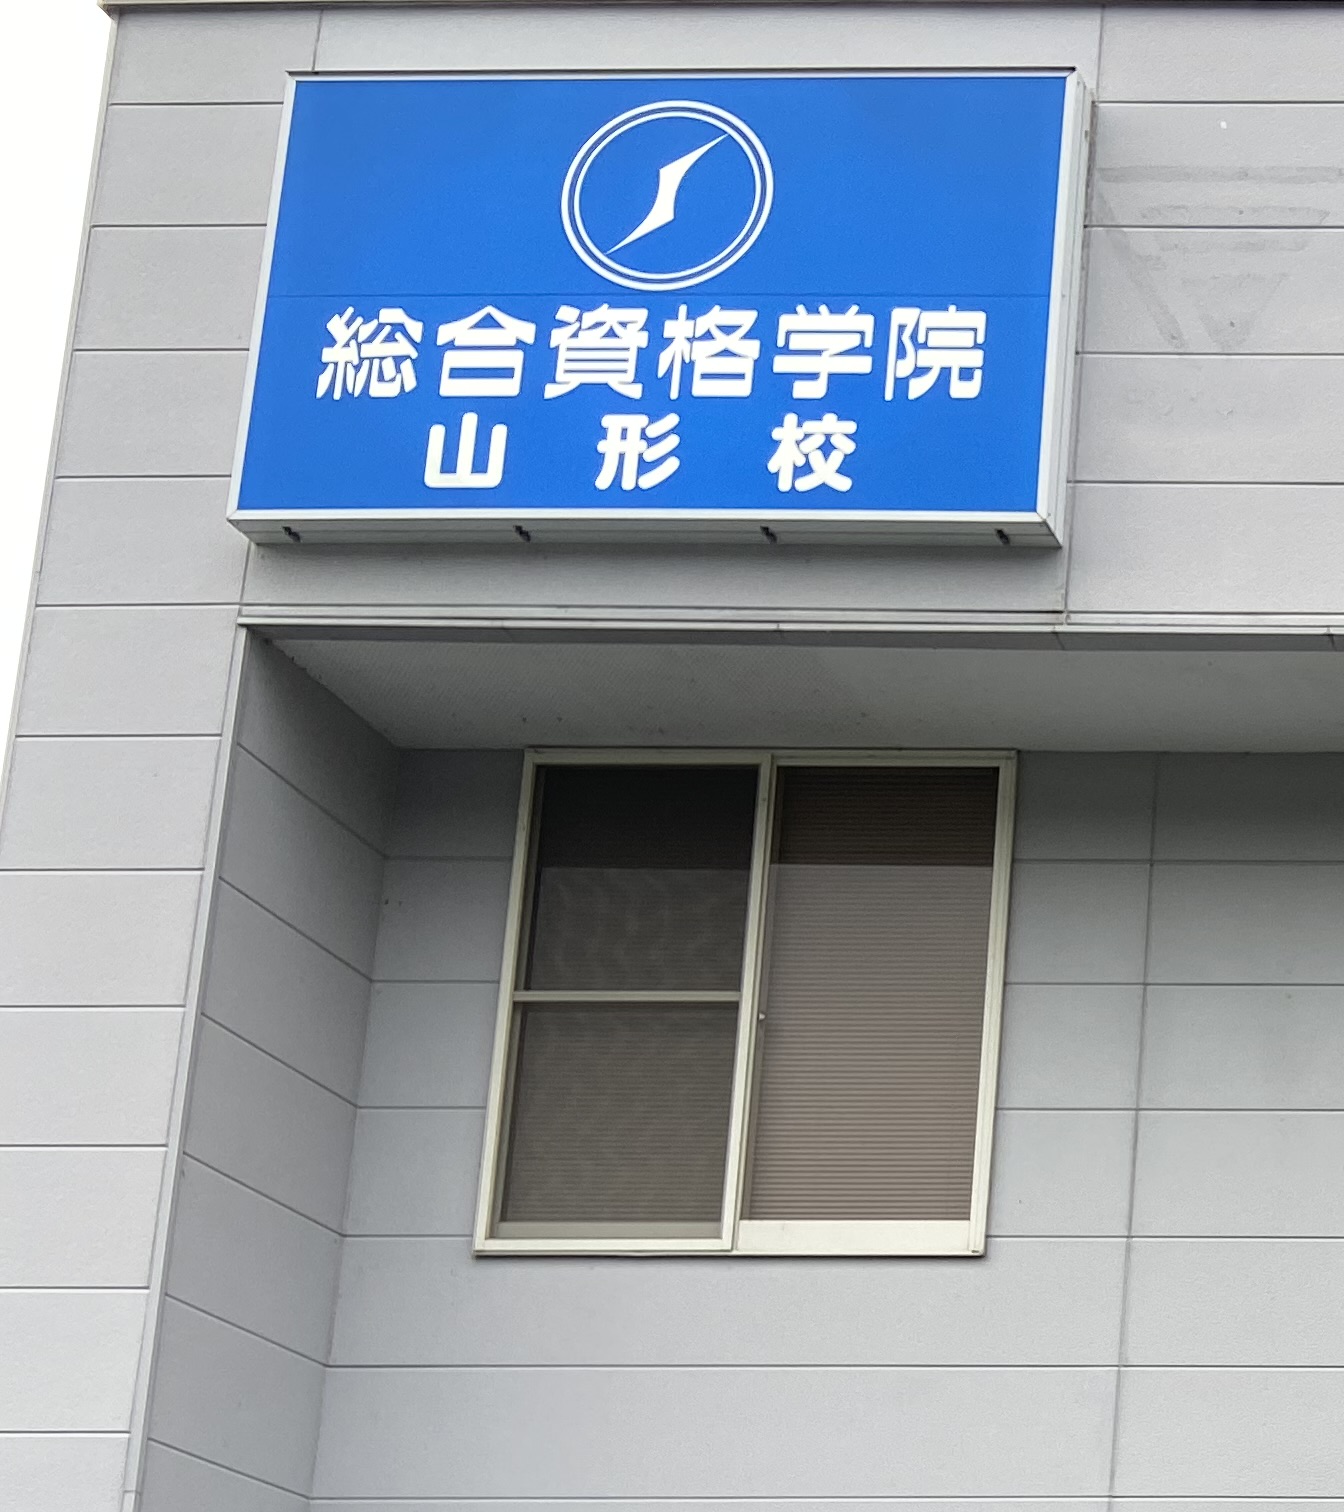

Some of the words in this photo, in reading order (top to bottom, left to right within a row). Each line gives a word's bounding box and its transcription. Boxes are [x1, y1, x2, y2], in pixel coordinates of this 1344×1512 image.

[316, 303, 988, 402] 総合資格学院
[424, 412, 858, 493] 山形校
